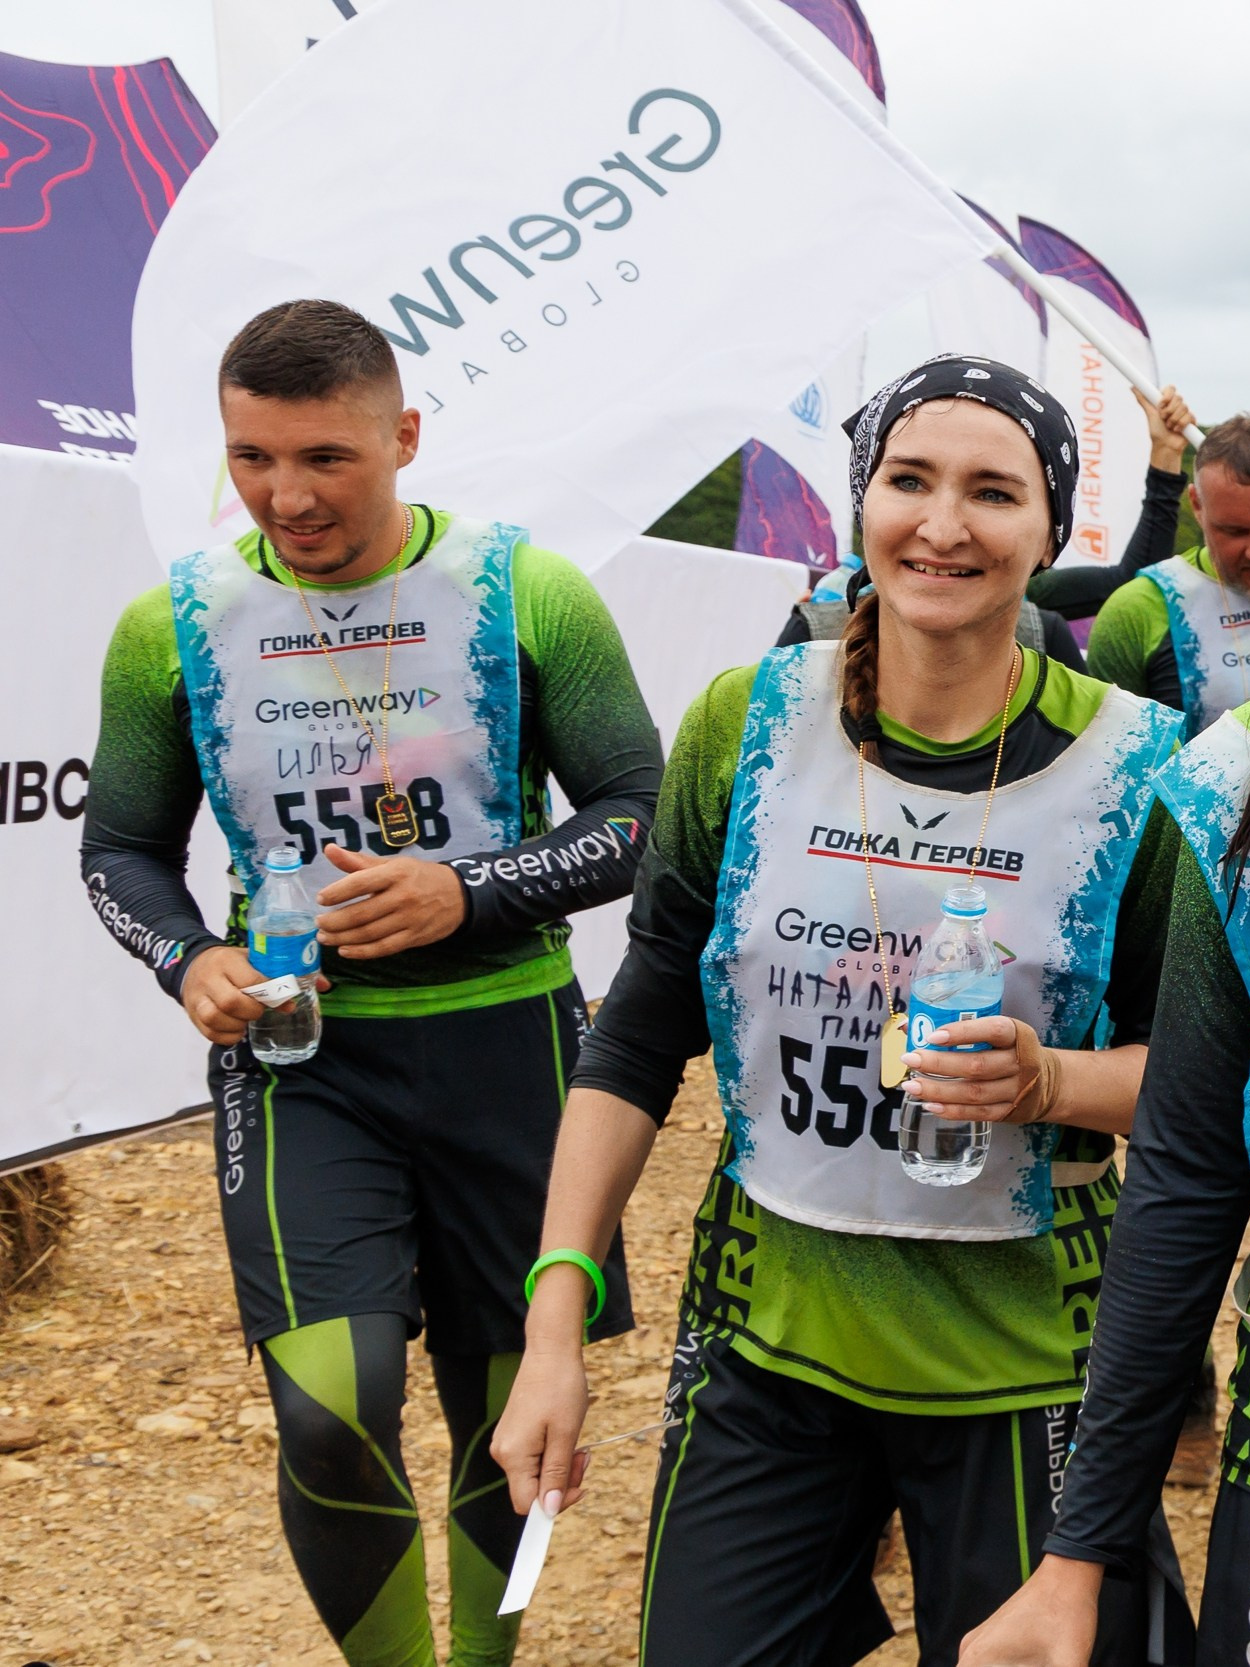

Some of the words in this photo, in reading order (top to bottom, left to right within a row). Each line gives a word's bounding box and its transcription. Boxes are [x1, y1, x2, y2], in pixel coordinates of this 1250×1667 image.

[259, 631, 333, 654] ГОНКА
[339, 621, 426, 644] ГЕРОЕВ
[255, 689, 417, 723] Greenway
[308, 719, 384, 732] GLOBAL
[277, 731, 373, 779] ИЛЬЯ
[273, 777, 452, 865] 5558
[451, 823, 622, 886] Greenway
[808, 825, 900, 858] ГОНКА
[910, 841, 1025, 873] ГЕРОЕВ
[836, 958, 912, 976] GLOB
[220, 1038, 248, 1195] Greenwa
